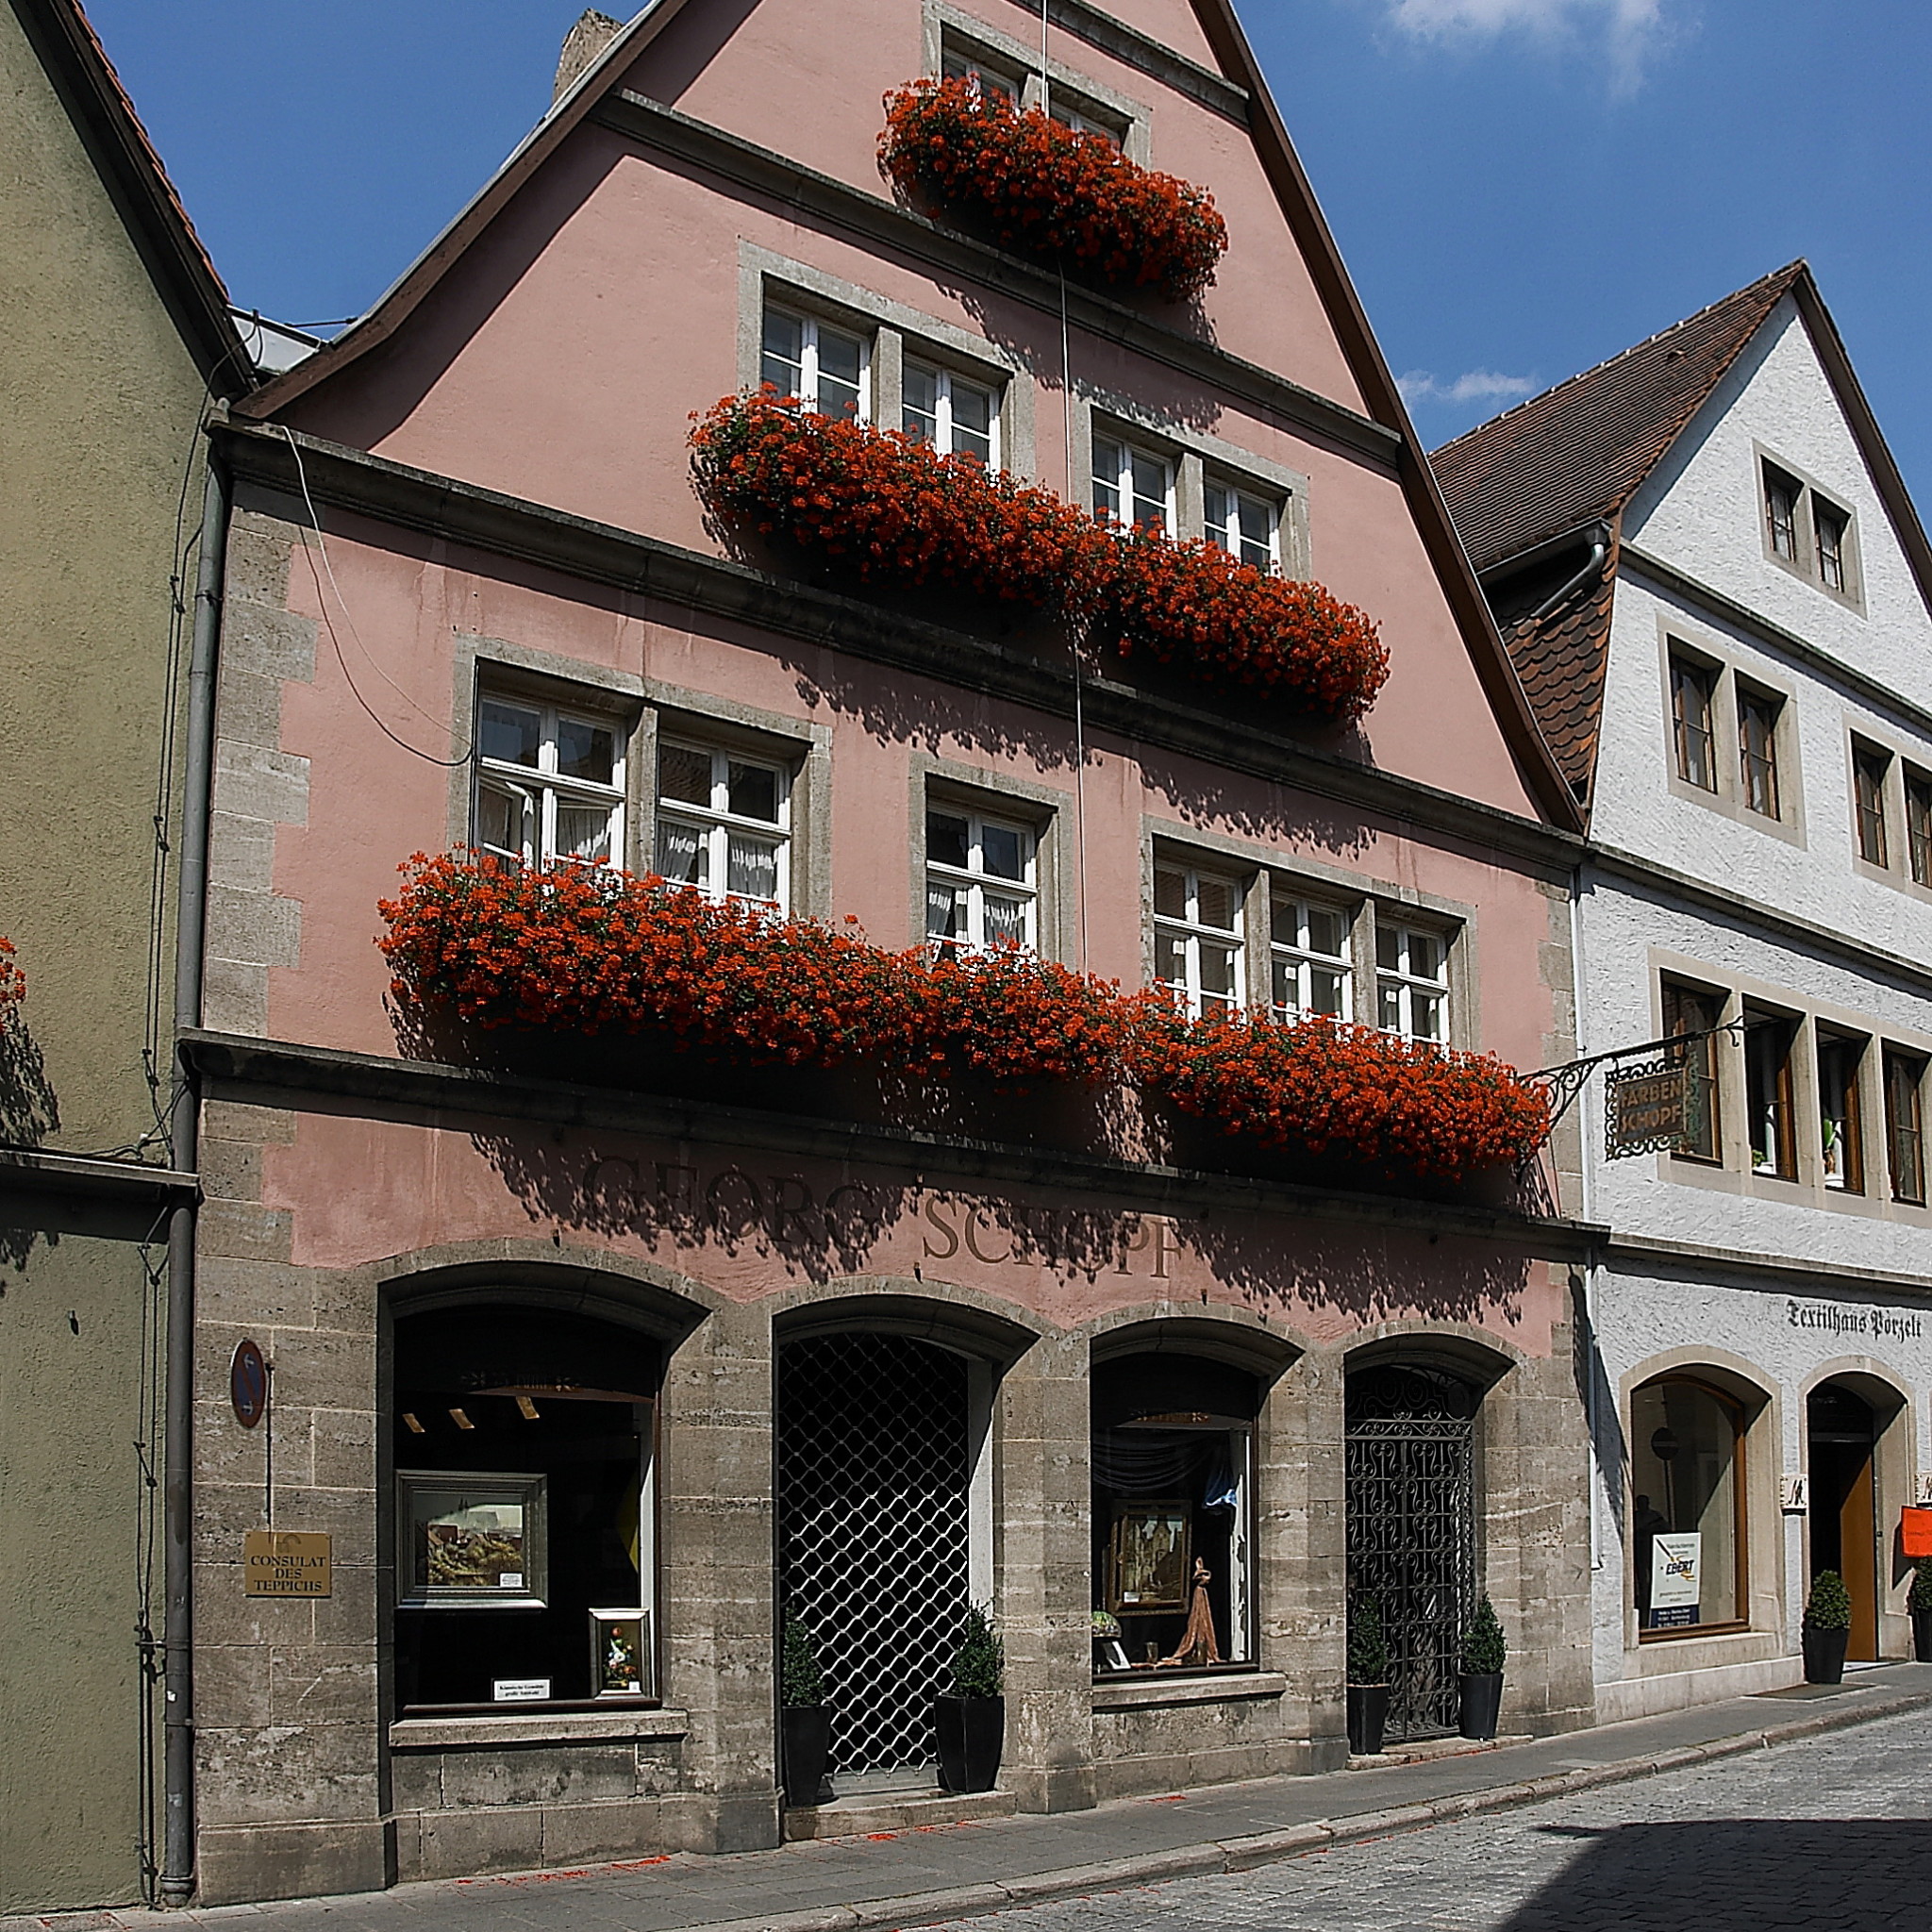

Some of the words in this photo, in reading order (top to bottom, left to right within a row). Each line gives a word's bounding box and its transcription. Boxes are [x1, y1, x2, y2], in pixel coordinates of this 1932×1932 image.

[1622, 1078, 1680, 1108] FARBEN
[1622, 1104, 1681, 1132] SCHOPF
[582, 1155, 885, 1251] GEORG
[1786, 1299, 1867, 1337] Textilhaus
[250, 1555, 326, 1567] CONSULAT
[1665, 1559, 1695, 1575] EBERT
[275, 1568, 302, 1579] DES
[254, 1579, 322, 1592] TEPPICHS
